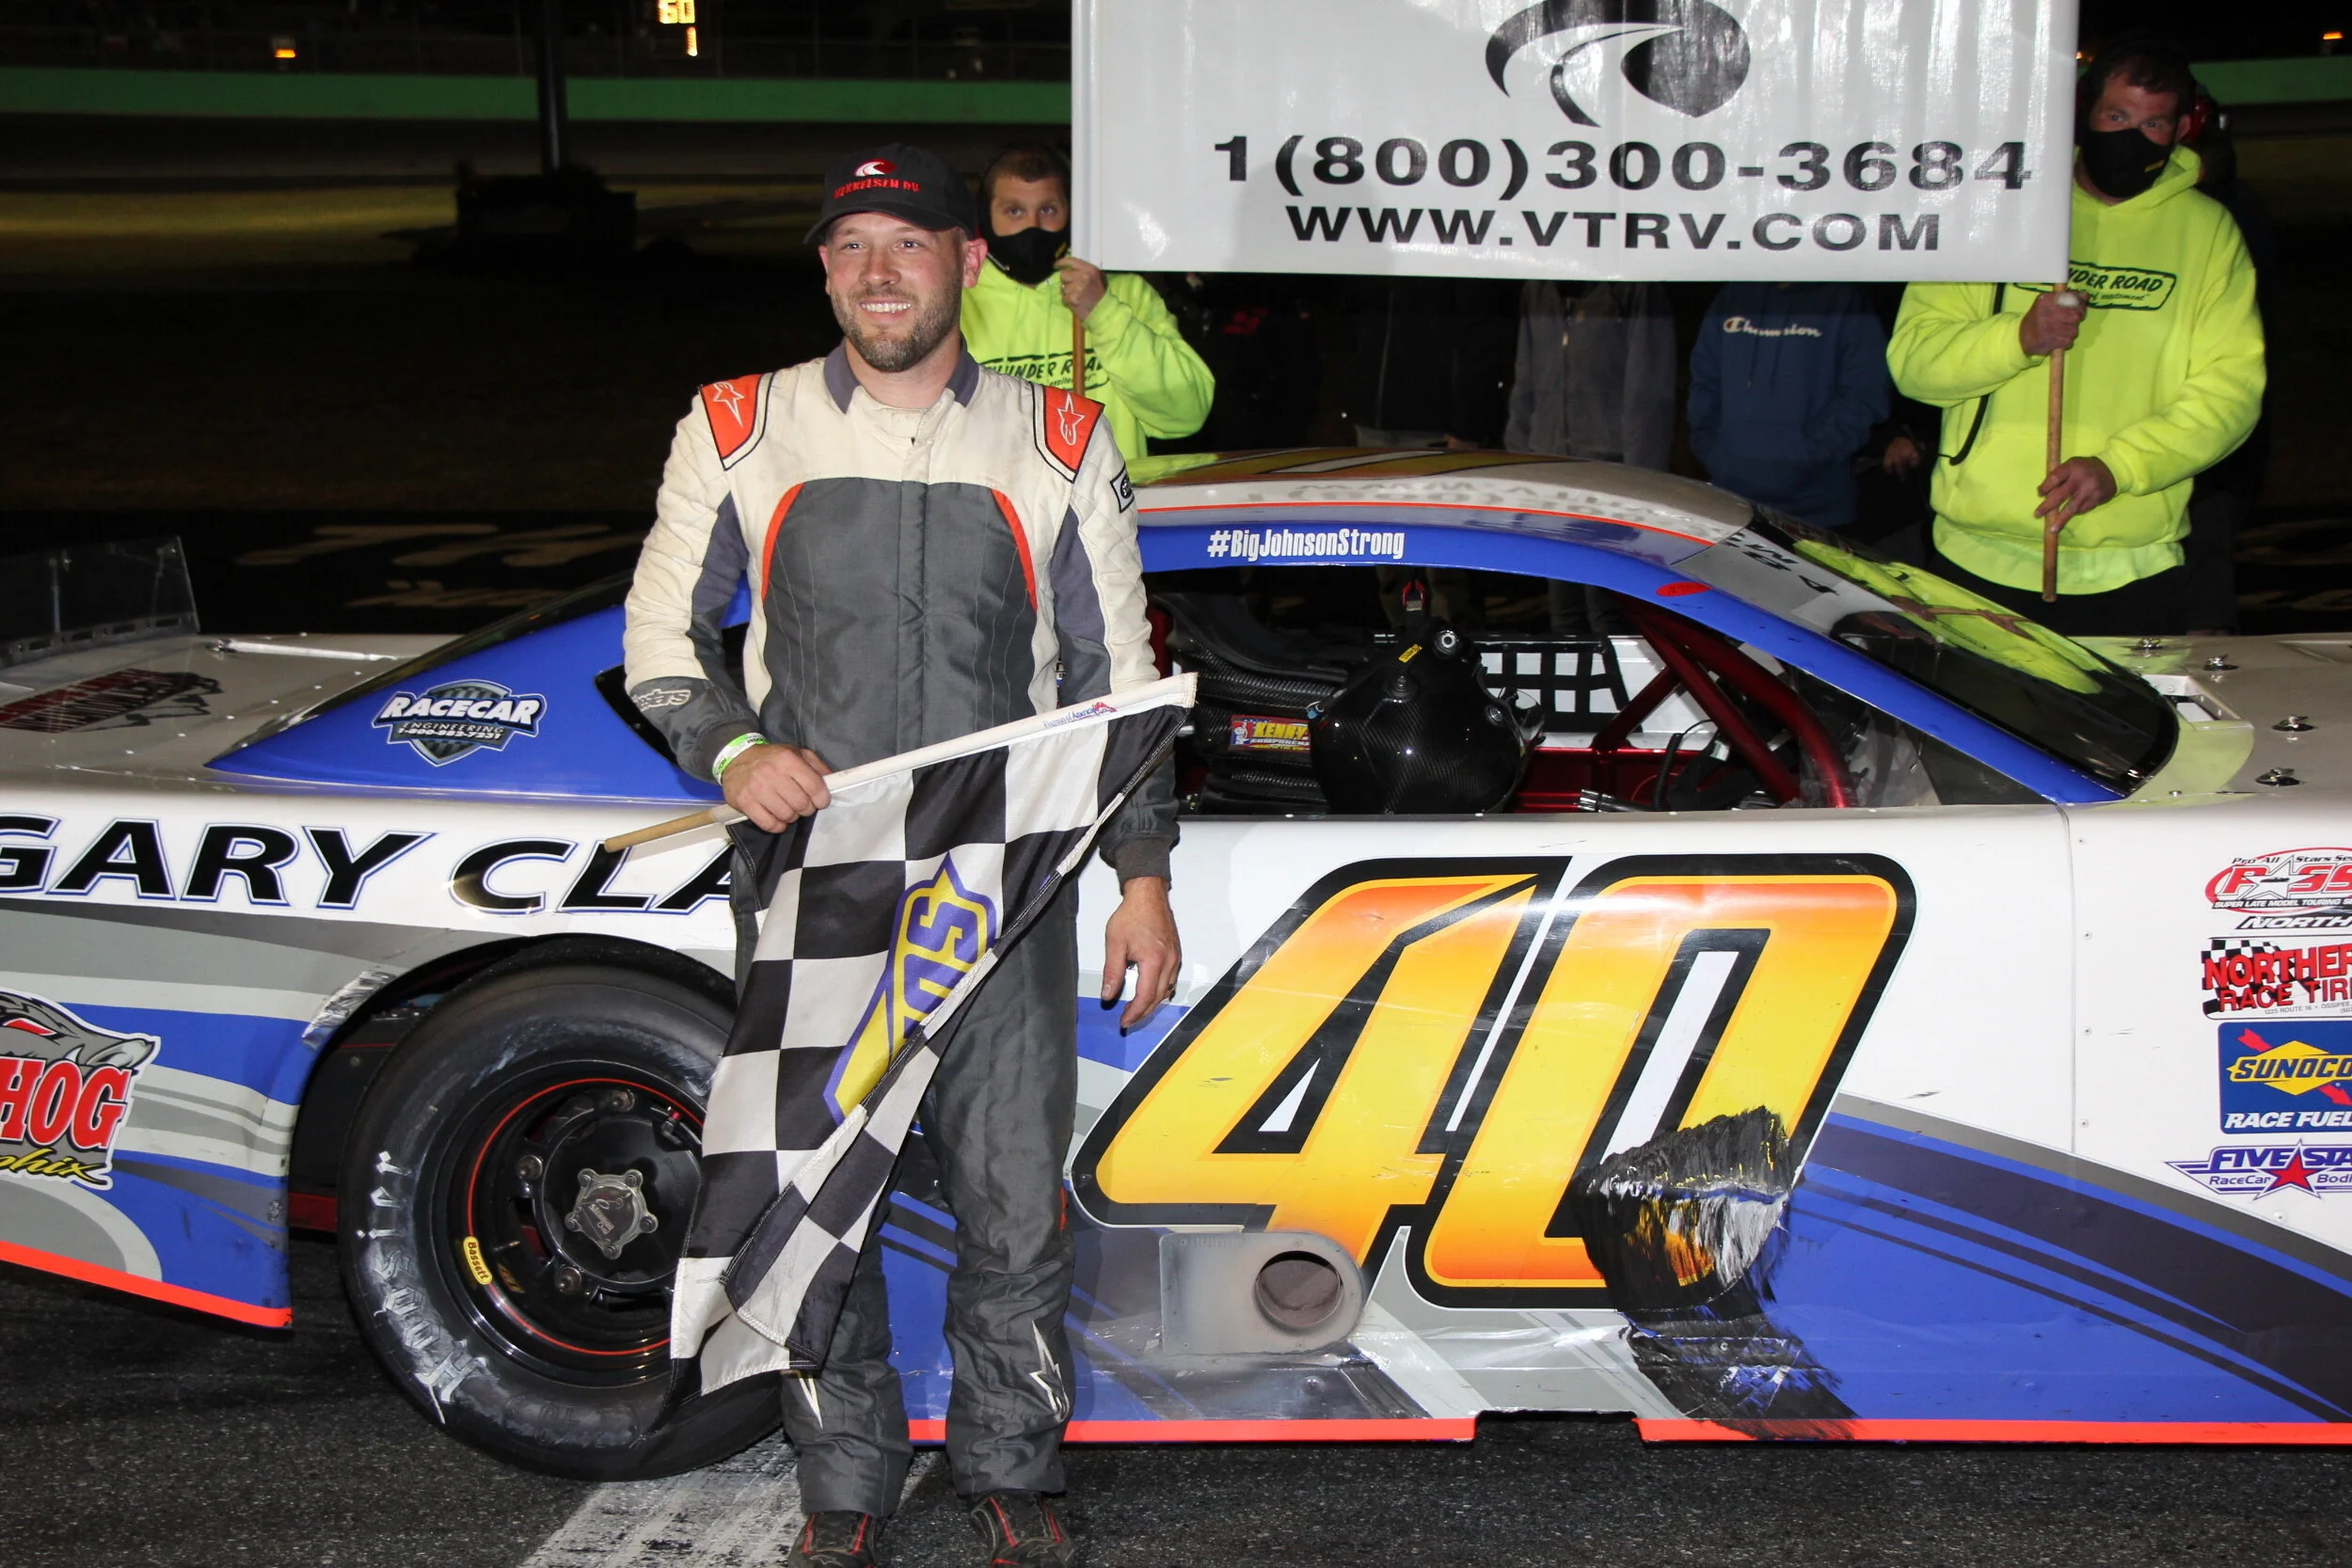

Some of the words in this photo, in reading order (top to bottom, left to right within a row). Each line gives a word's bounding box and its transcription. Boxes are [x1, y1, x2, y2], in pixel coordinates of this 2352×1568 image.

[1285, 205, 1939, 251] WWW.VTRV.COM
[2110, 276, 2164, 292] ROAD
[1207, 528, 1405, 562] #BigJohnsonStrong
[380, 696, 540, 725] RACECAR
[402, 721, 505, 734] ENGINEERING
[2215, 900, 2244, 909] SUPER
[2241, 916, 2352, 928] NORTH
[2218, 983, 2294, 1012] RACE
[2304, 977, 2352, 1004] TIR
[2233, 1057, 2352, 1080] SUNOCO
[1073, 854, 1916, 1309] 40
[2224, 1111, 2295, 1128] RACE
[2211, 1148, 2296, 1172] FIVE
[2209, 1175, 2270, 1185] RaceCar
[468, 1241, 490, 1280] Bassett
